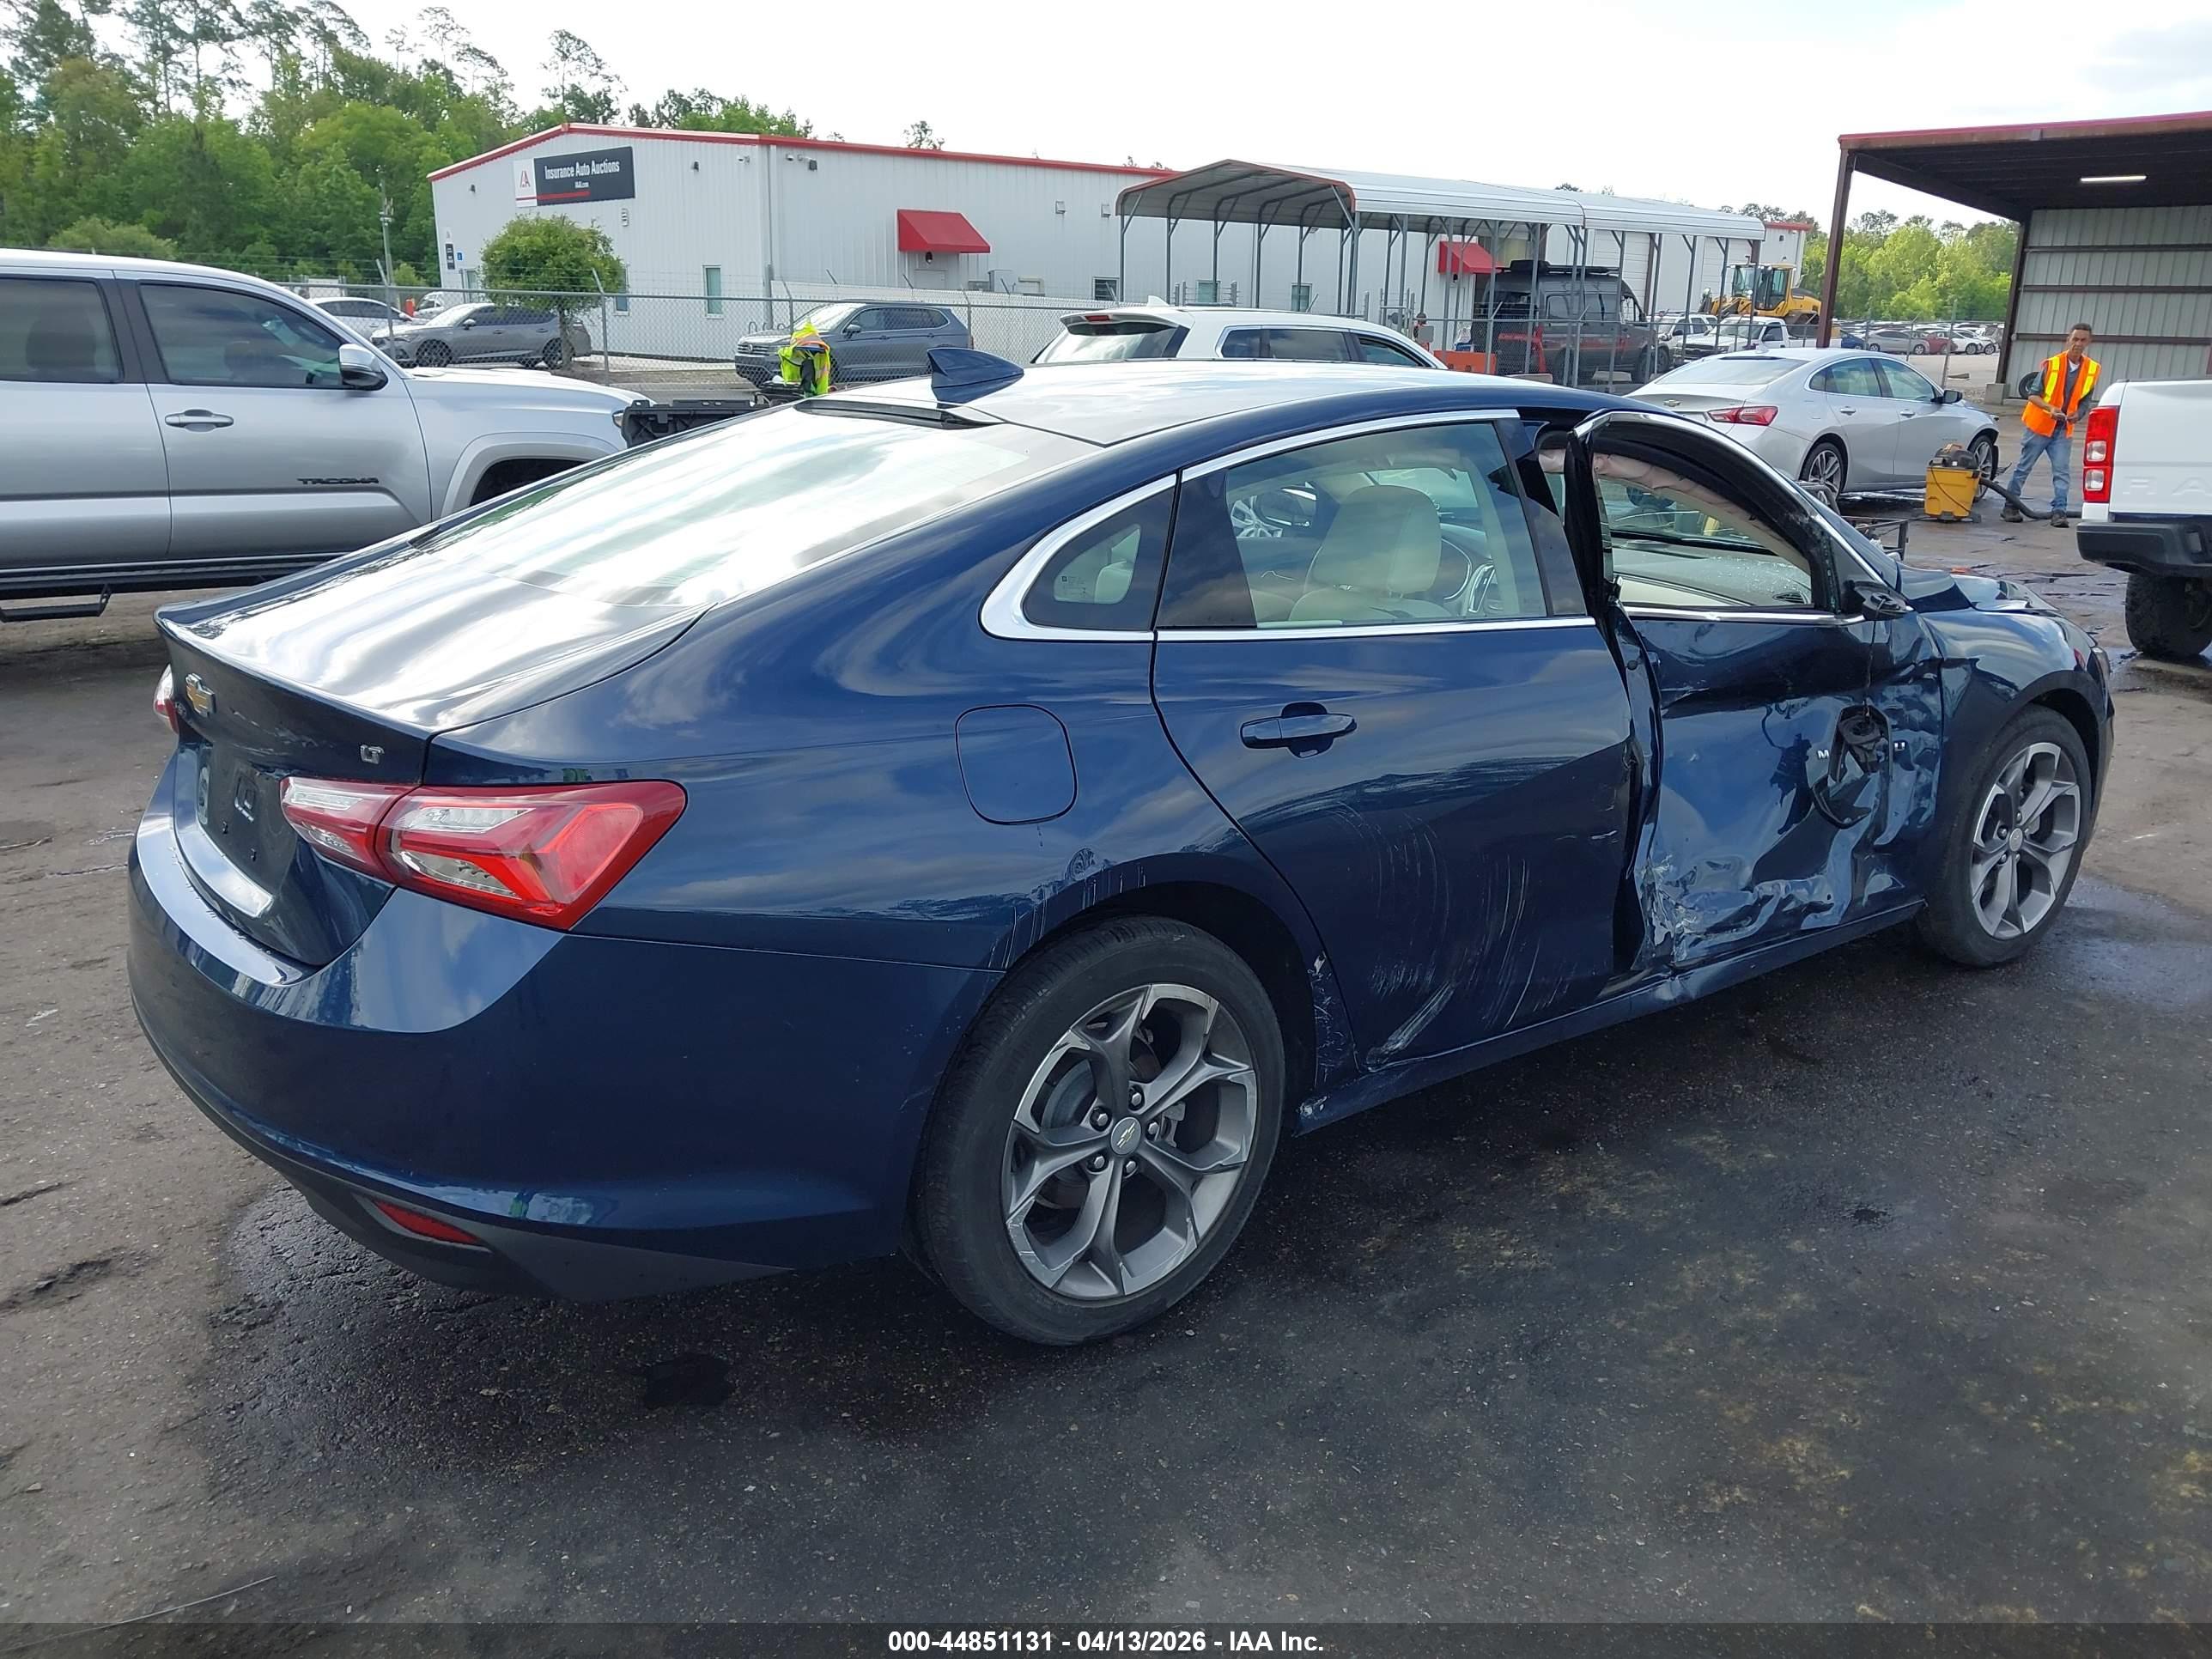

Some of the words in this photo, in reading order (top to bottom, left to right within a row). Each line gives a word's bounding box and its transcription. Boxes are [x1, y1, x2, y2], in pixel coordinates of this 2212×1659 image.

[544, 166, 574, 179] Insurance
[575, 162, 591, 177] Auto
[591, 159, 620, 175] Auctions
[360, 744, 385, 764] LT
